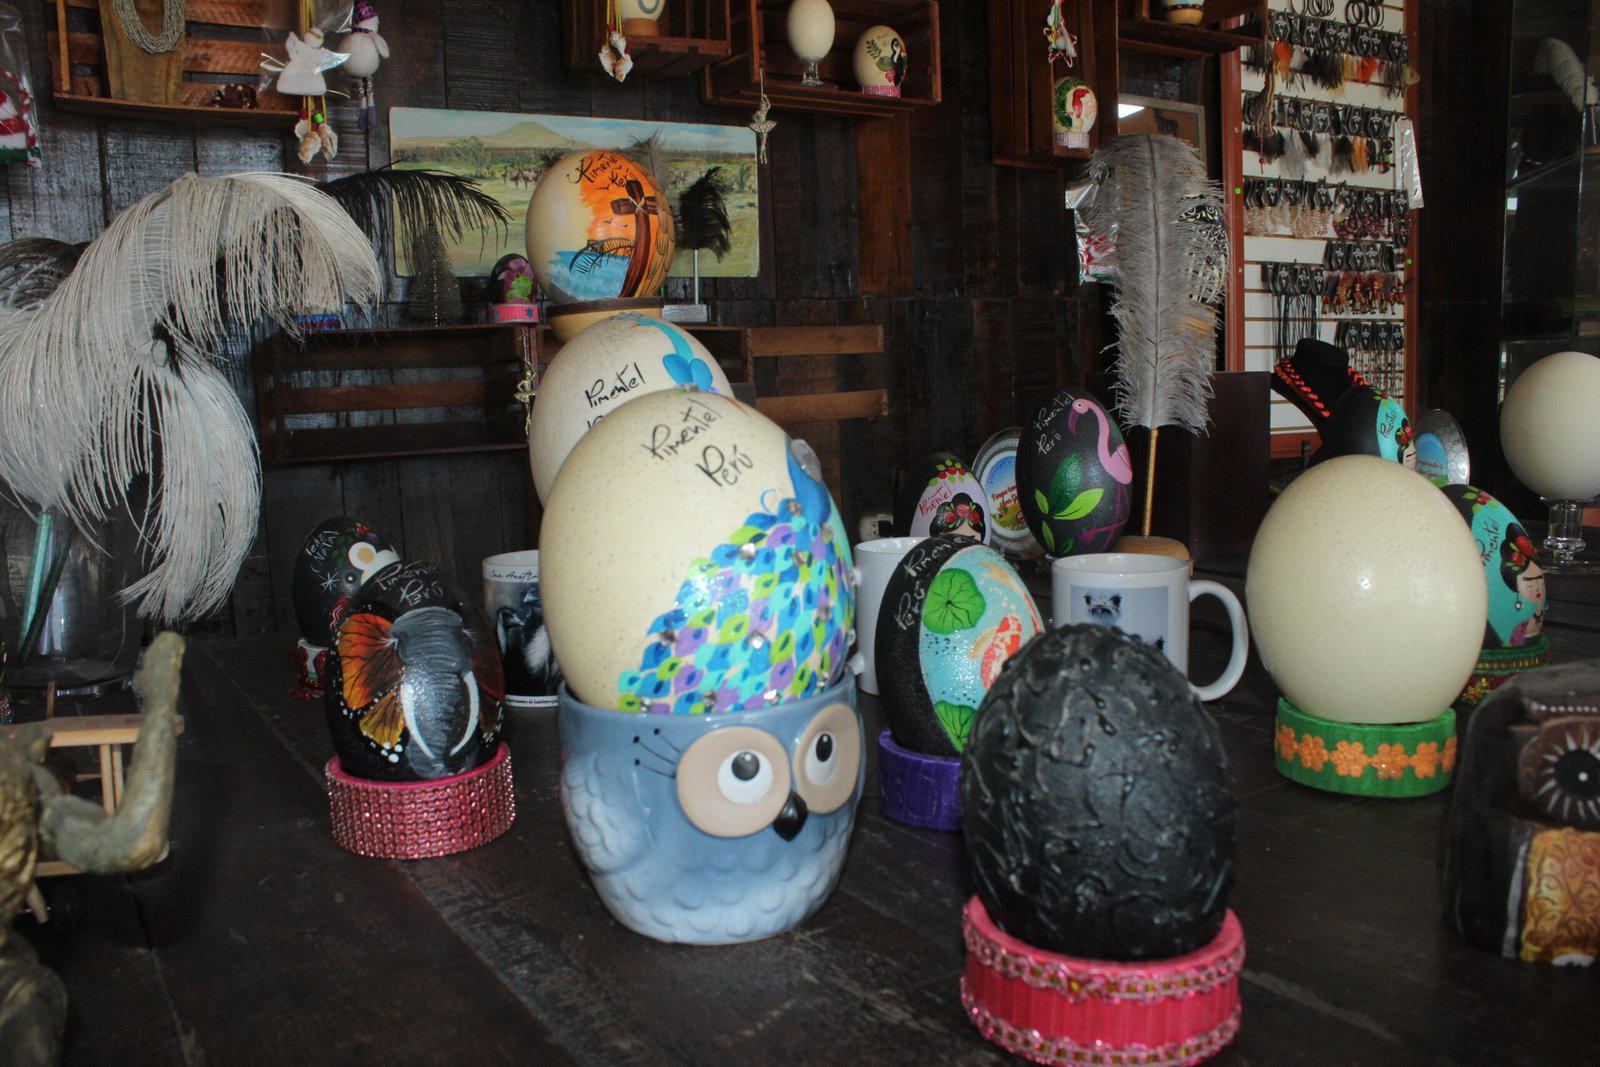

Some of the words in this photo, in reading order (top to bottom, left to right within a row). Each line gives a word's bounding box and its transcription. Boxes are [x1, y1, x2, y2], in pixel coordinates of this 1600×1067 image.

[584, 362, 646, 408] Pimentel
[641, 398, 723, 460] Pimentel
[1033, 391, 1076, 430] Pimentel
[695, 444, 753, 487] Perú
